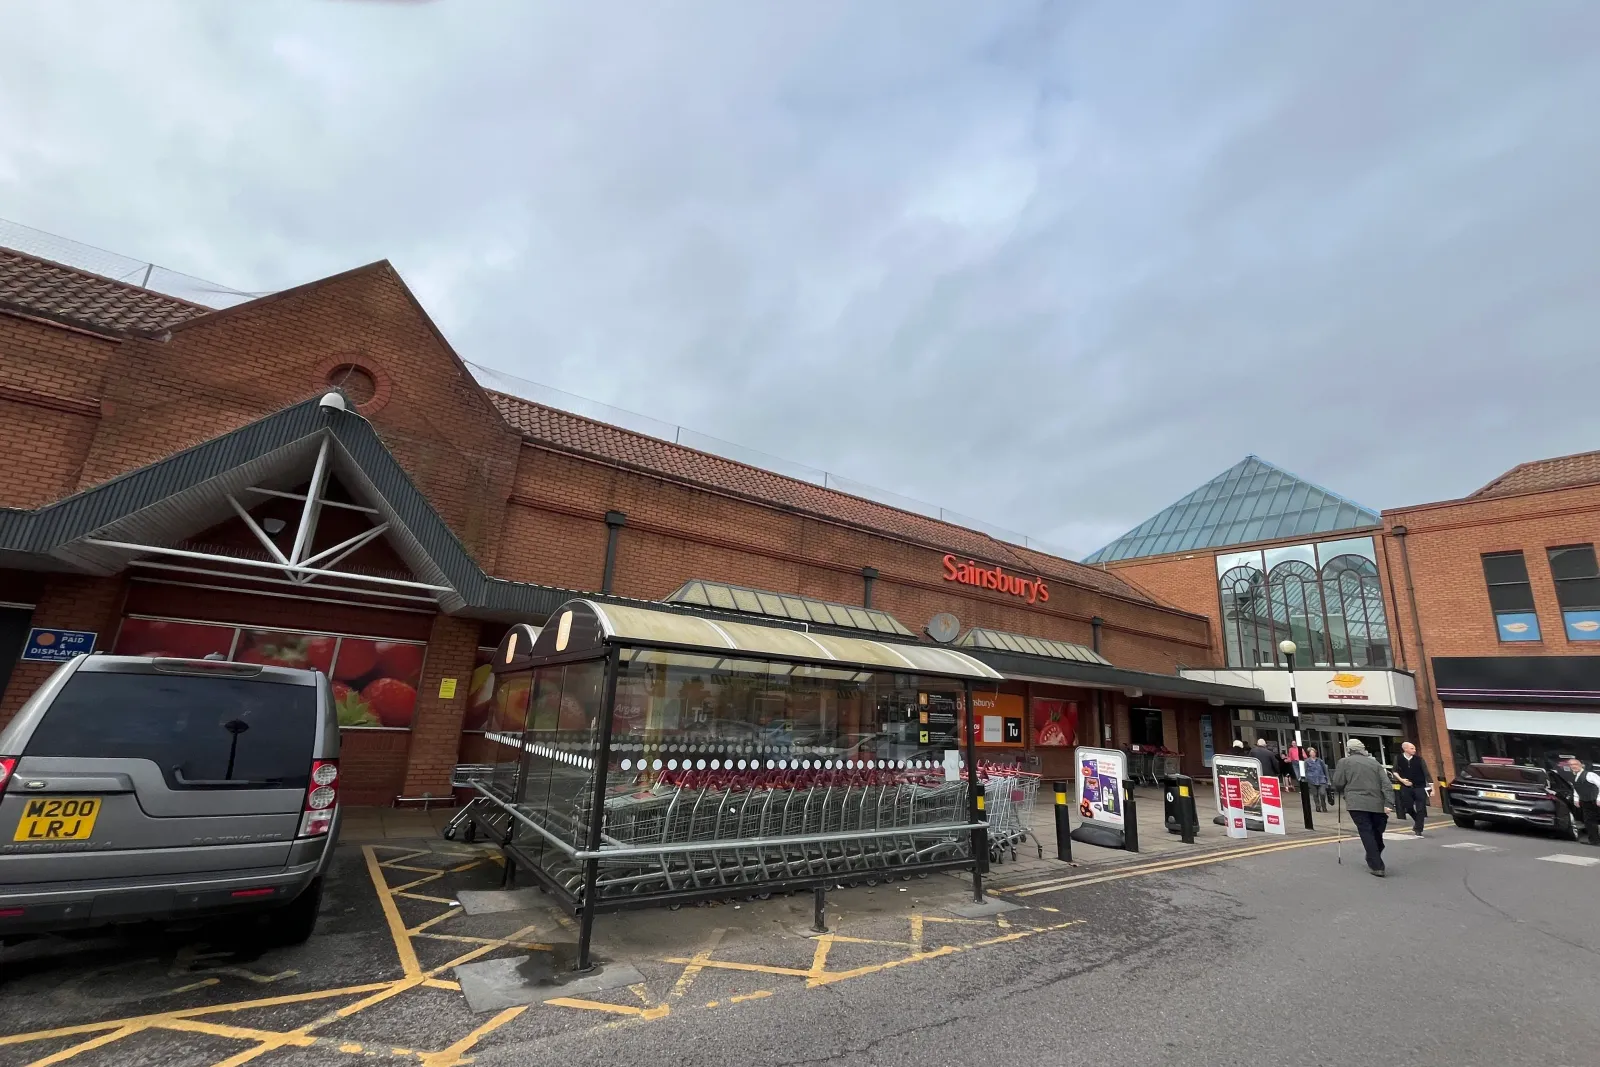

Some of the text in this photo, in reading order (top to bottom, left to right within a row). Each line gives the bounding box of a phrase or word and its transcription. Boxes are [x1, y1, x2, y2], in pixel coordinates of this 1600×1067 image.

[943, 554, 1049, 604] Sainsbury's
[61, 636, 84, 644] PAID
[614, 703, 640, 715] Argos
[1007, 722, 1019, 737] Tu
[26, 800, 95, 818] M200
[28, 820, 82, 838] LRJ
